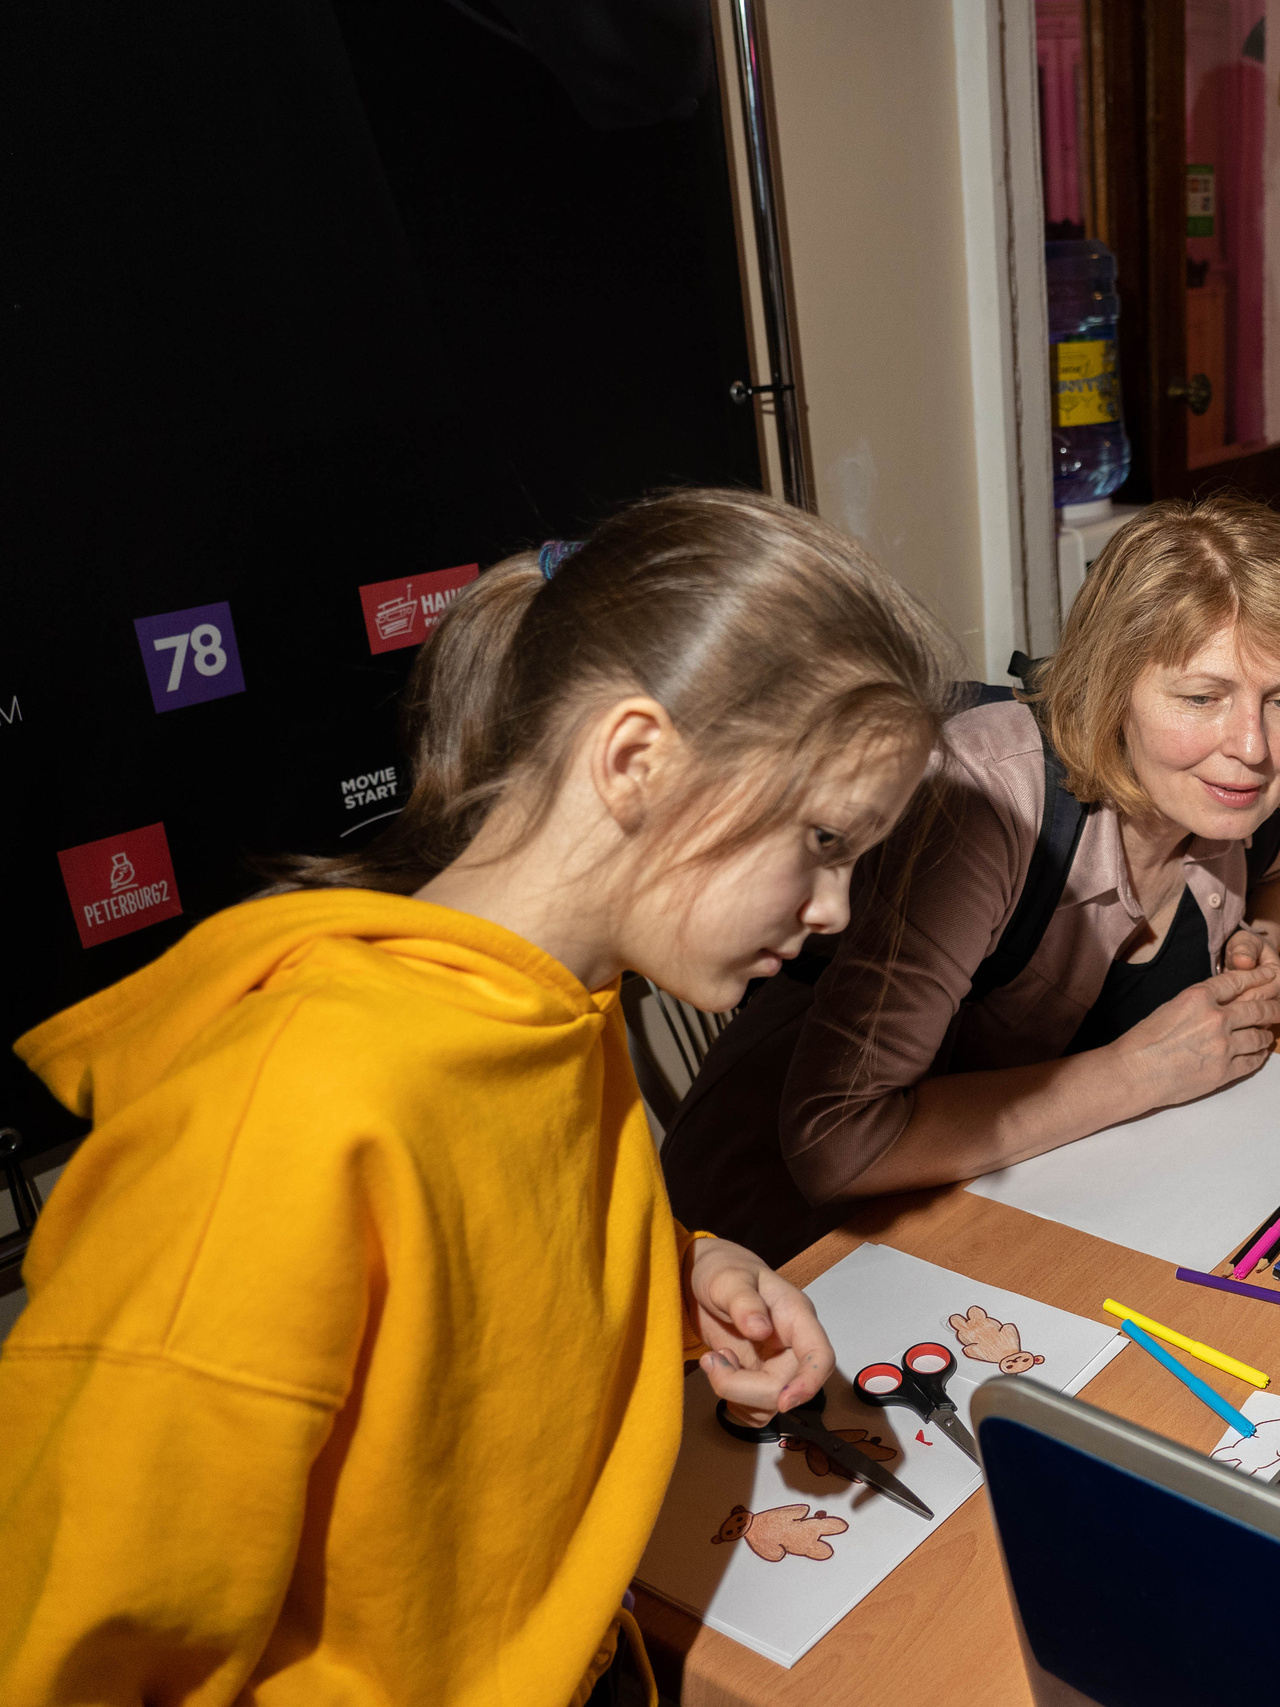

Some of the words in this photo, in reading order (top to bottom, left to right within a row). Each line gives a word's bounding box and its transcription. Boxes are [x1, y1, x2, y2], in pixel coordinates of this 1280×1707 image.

[153, 624, 227, 693] 78
[341, 766, 397, 795] MOVIE
[344, 781, 398, 810] START
[83, 880, 171, 928] PETERBURG2
